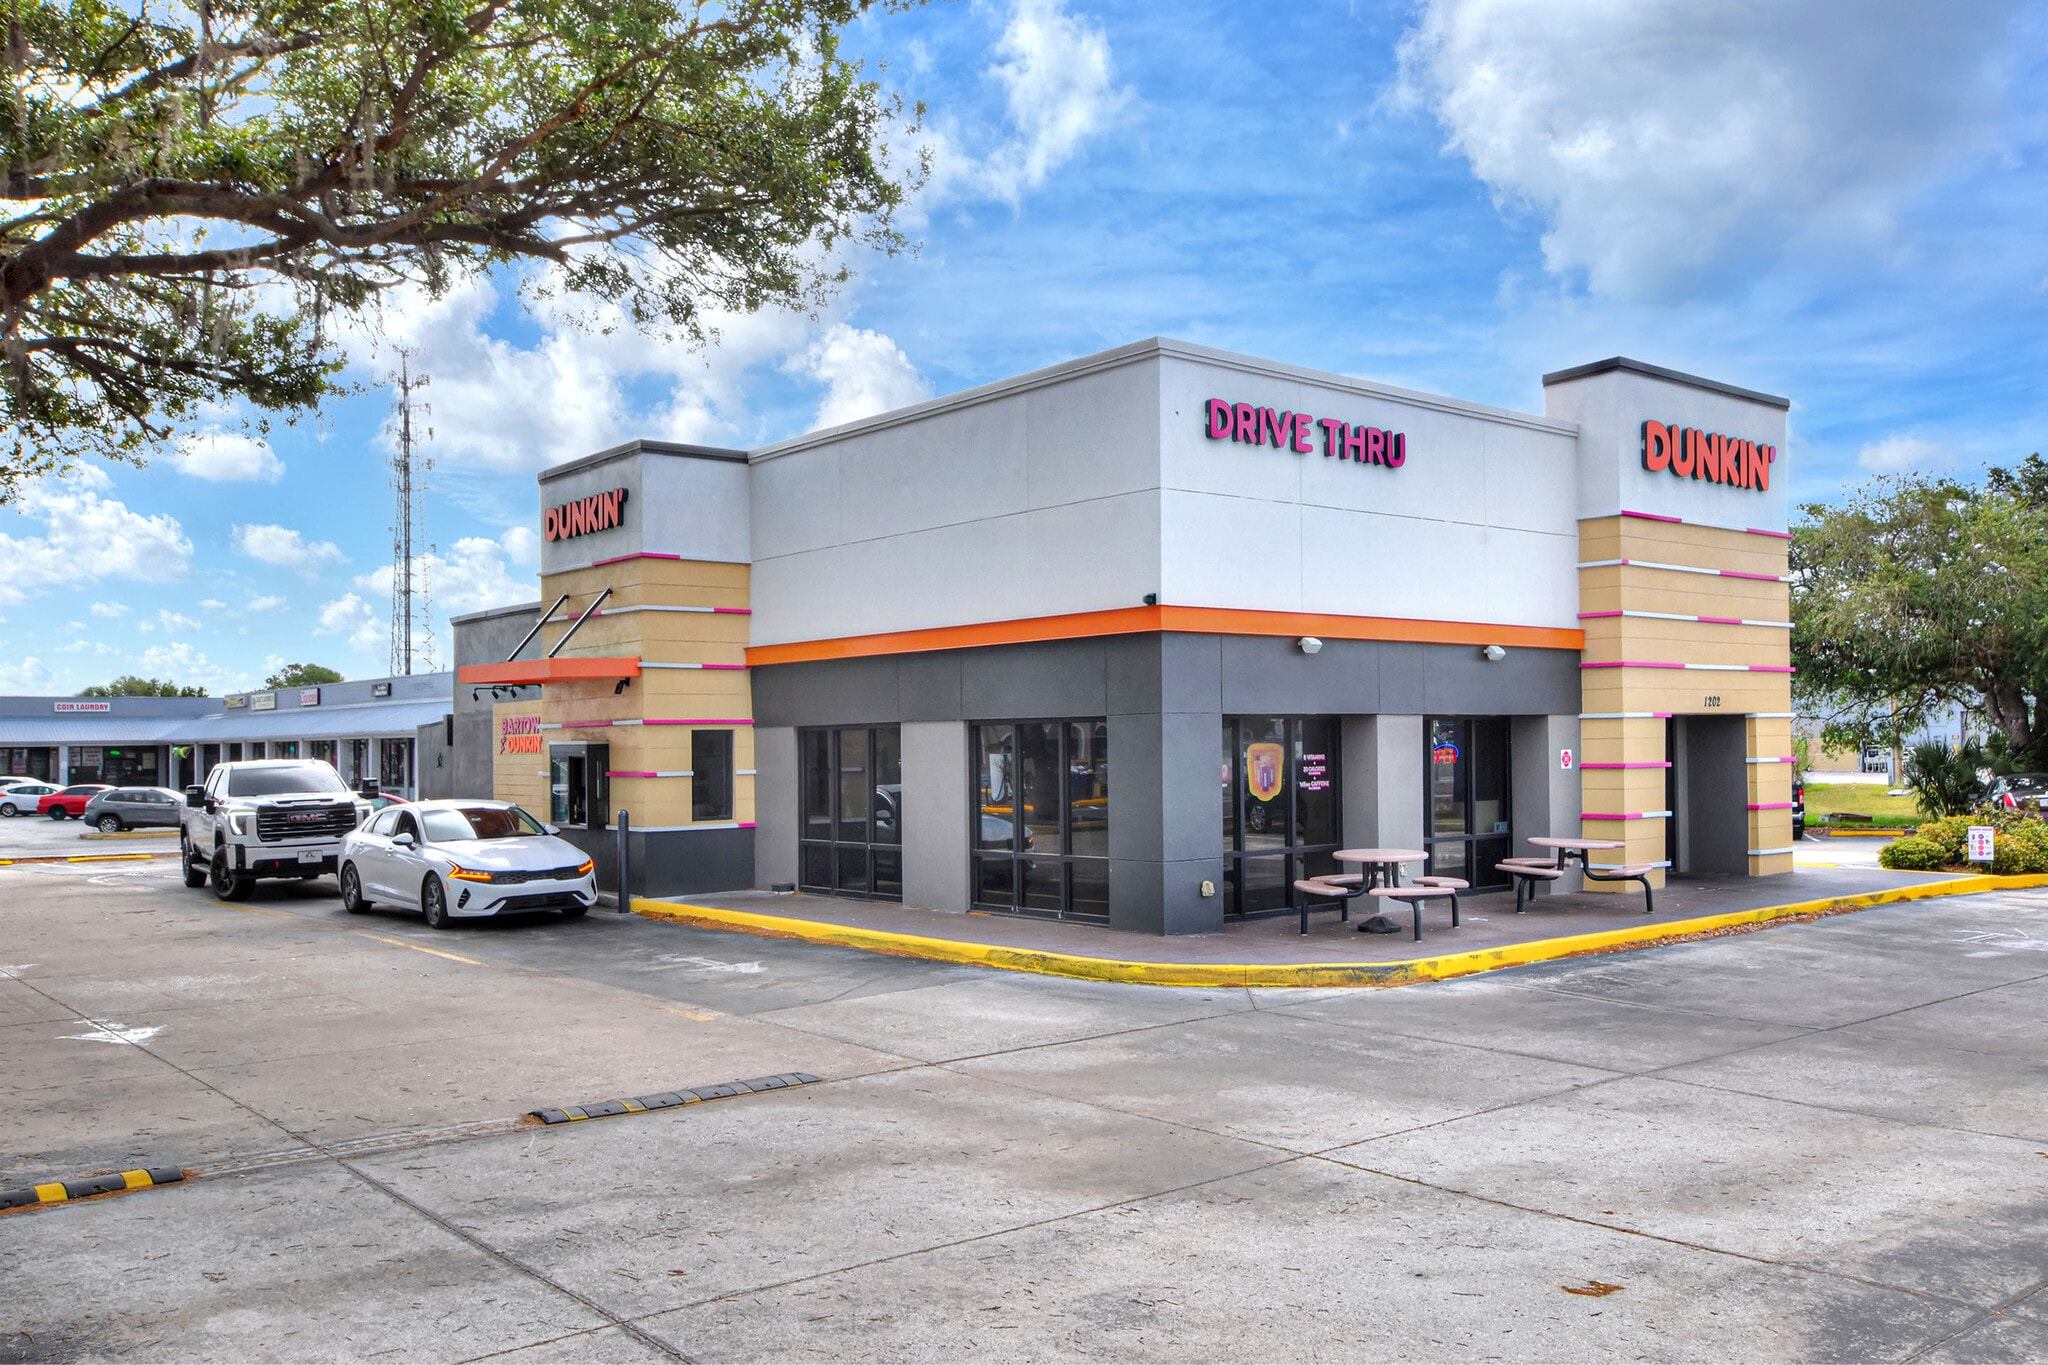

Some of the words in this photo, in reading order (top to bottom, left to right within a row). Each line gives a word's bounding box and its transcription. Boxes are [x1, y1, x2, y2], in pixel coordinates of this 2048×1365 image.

[1205, 398, 1313, 453] DRIVE
[1317, 418, 1406, 468] THRU
[1641, 419, 1776, 492] DUNKIN'
[544, 487, 628, 542] DUNKIN'
[56, 703, 75, 711] COIN
[76, 703, 109, 711] LAUNDRY
[1704, 695, 1721, 707] 1202
[501, 716, 541, 735] BARTOW
